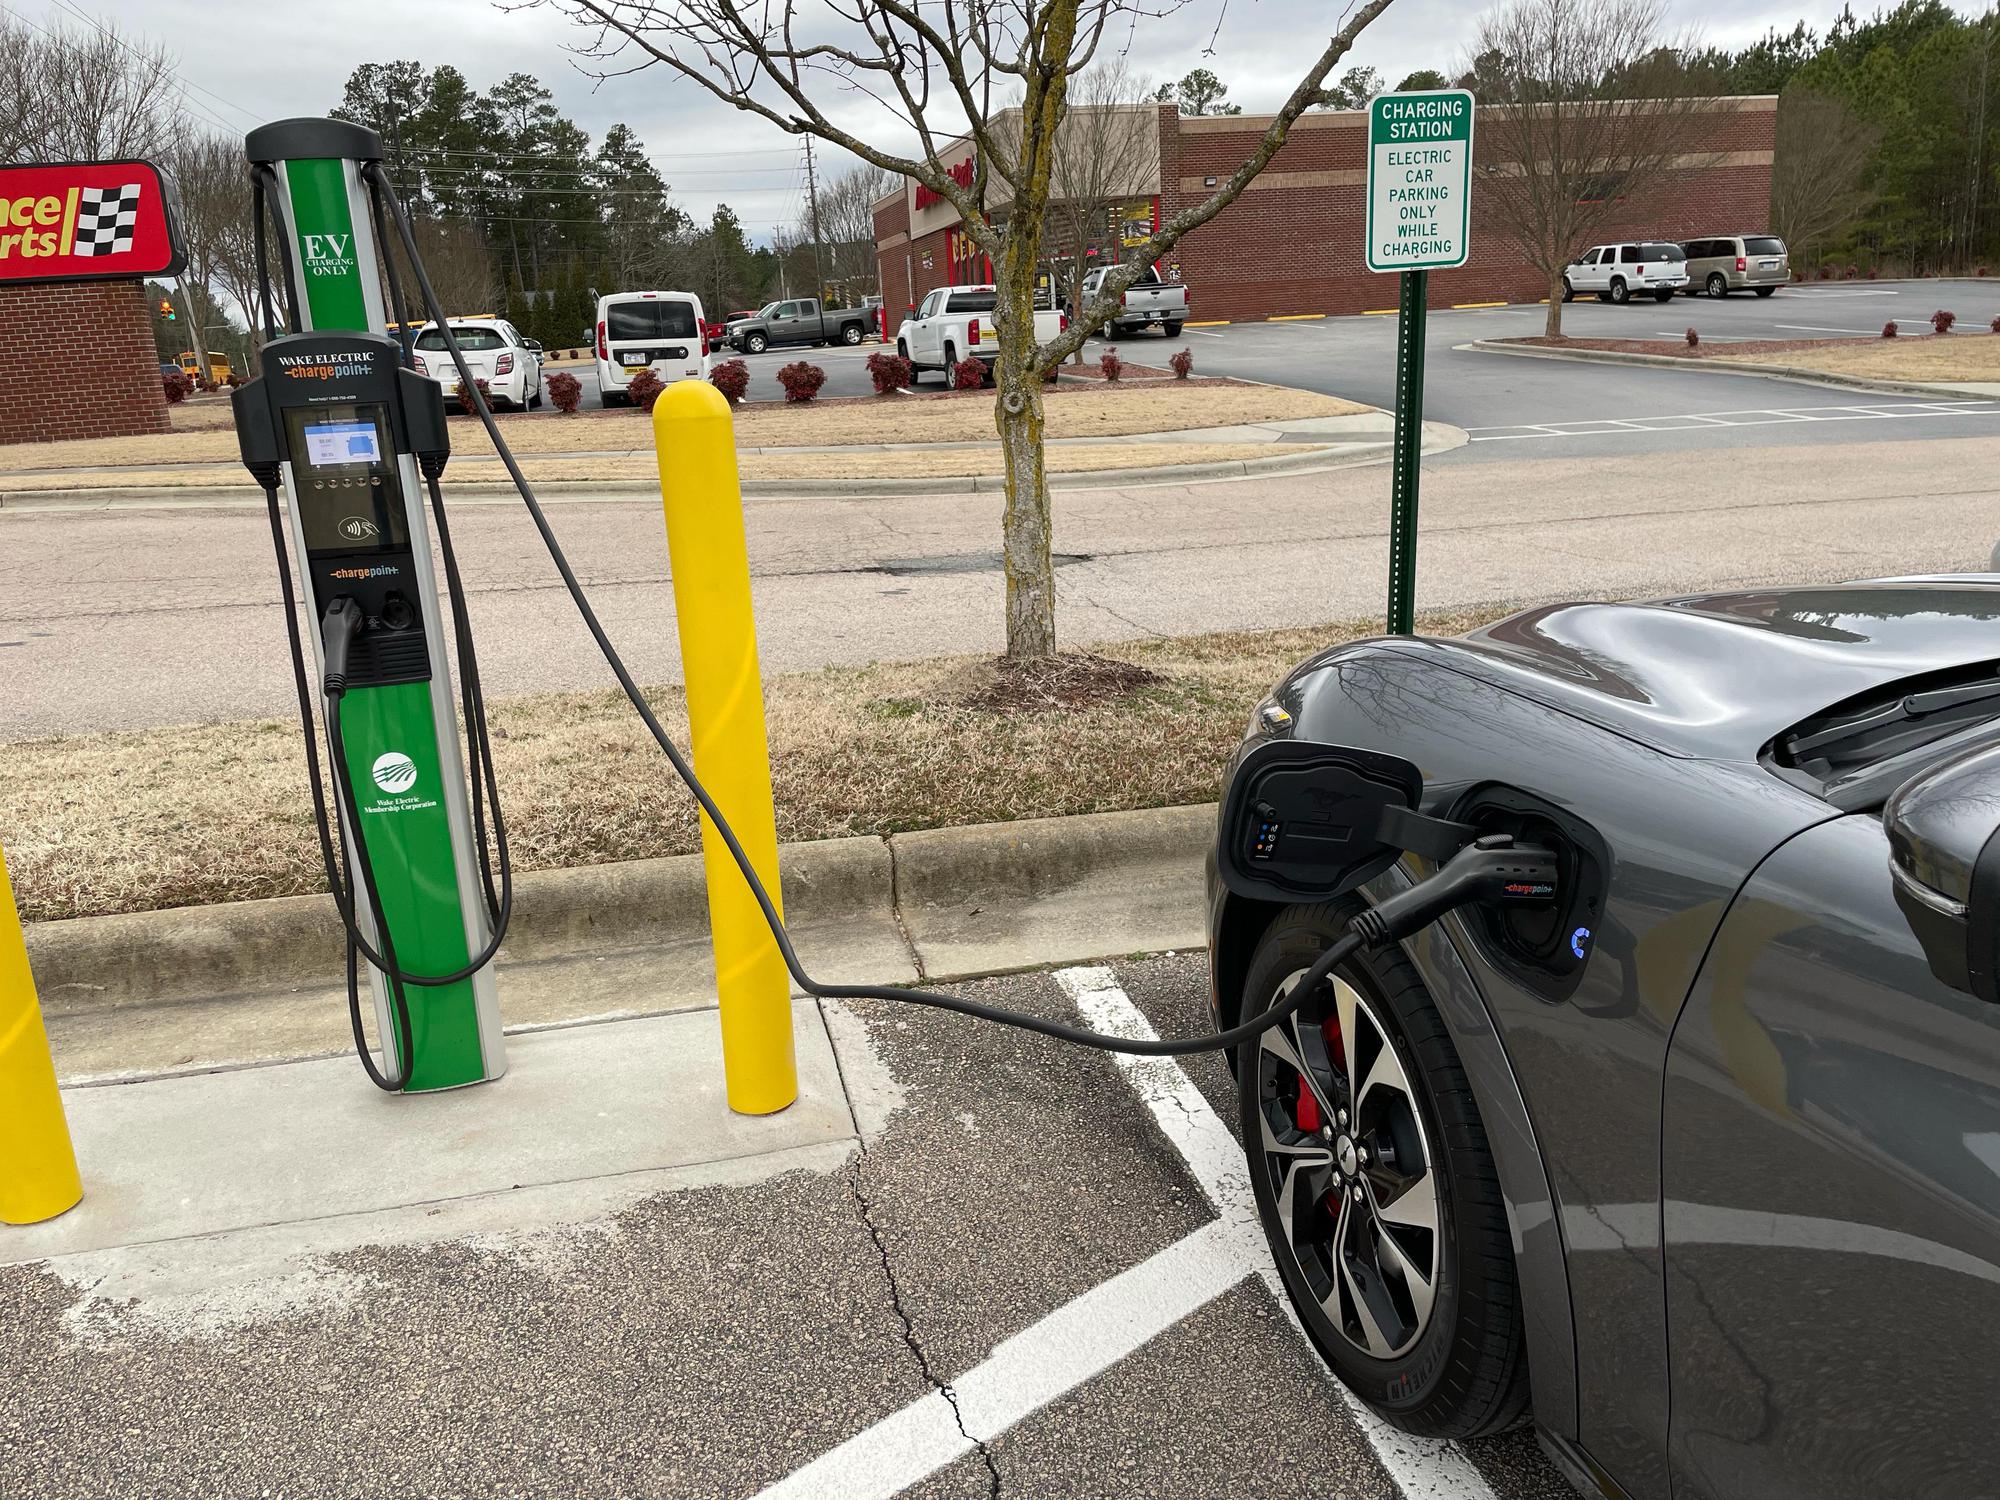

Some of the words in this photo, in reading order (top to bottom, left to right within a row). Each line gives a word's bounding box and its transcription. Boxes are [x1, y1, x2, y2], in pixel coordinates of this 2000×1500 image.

[1382, 100, 1462, 119] CHARGING
[1390, 121, 1452, 138] STATION
[1388, 150, 1452, 165] ELECTRIC
[1405, 169, 1433, 183] CAR
[1389, 187, 1448, 202] PARKING
[1400, 205, 1436, 219] ONLY
[1398, 223, 1438, 238] WHILE
[302, 234, 349, 260] EV
[1383, 240, 1452, 256] CHARGING
[306, 258, 353, 267] CHARGING
[313, 265, 349, 277] ONLY
[279, 355, 314, 366] WAKE
[316, 352, 375, 364] ELECTRIC
[364, 805, 400, 813] Membership
[401, 801, 437, 811] Corporation
[395, 796, 420, 805] Electric
